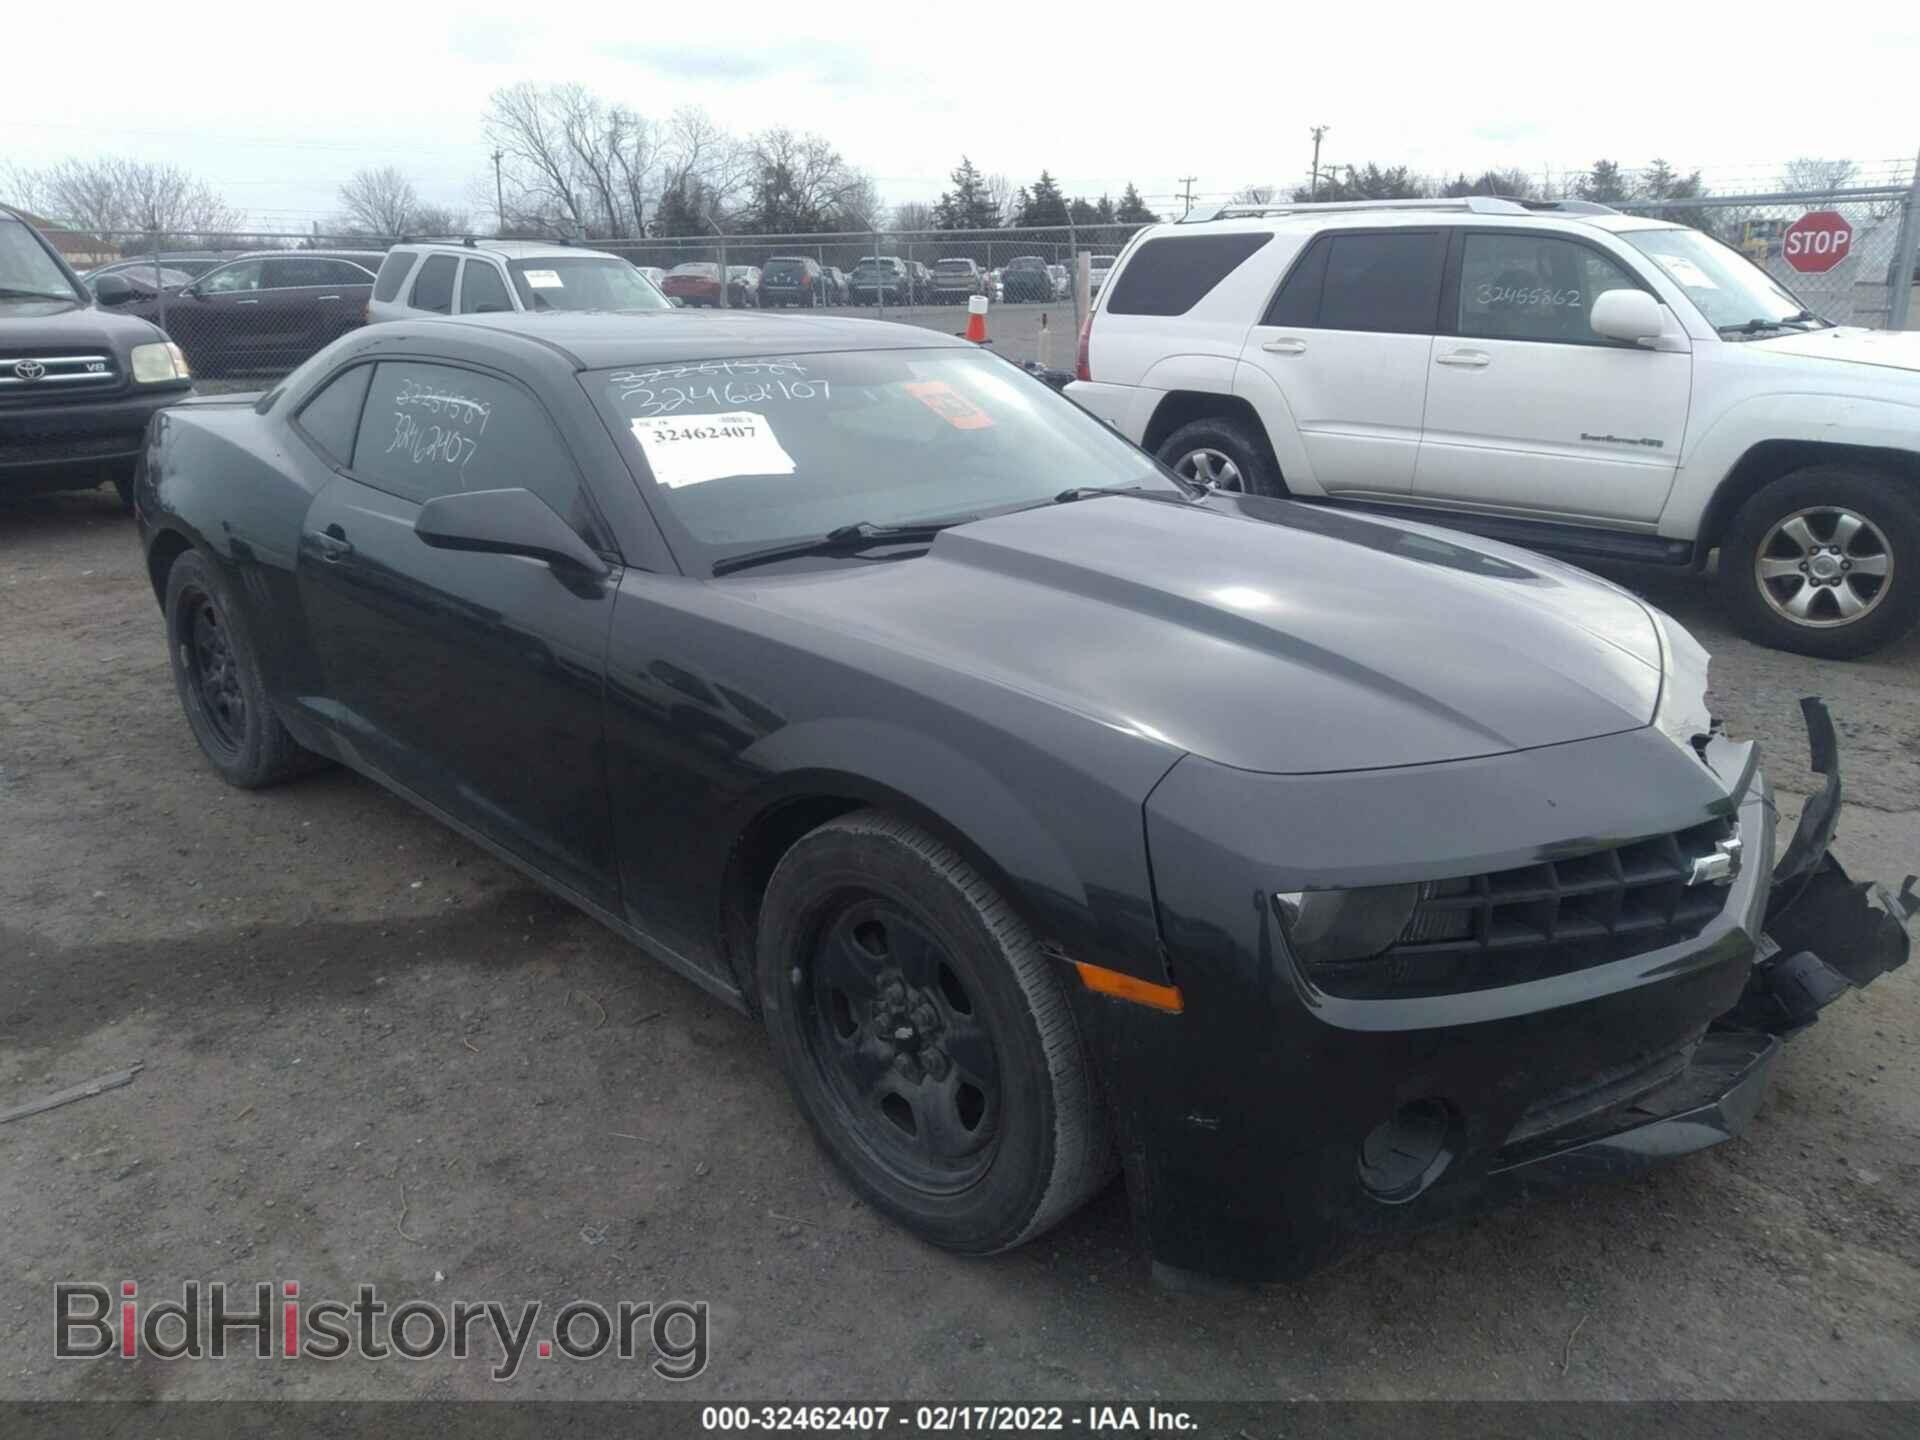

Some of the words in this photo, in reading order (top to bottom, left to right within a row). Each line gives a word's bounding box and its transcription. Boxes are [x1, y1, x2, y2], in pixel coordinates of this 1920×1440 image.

[1787, 230, 1849, 254] STOP
[86, 362, 105, 371] V8
[653, 426, 757, 443] 32462407
